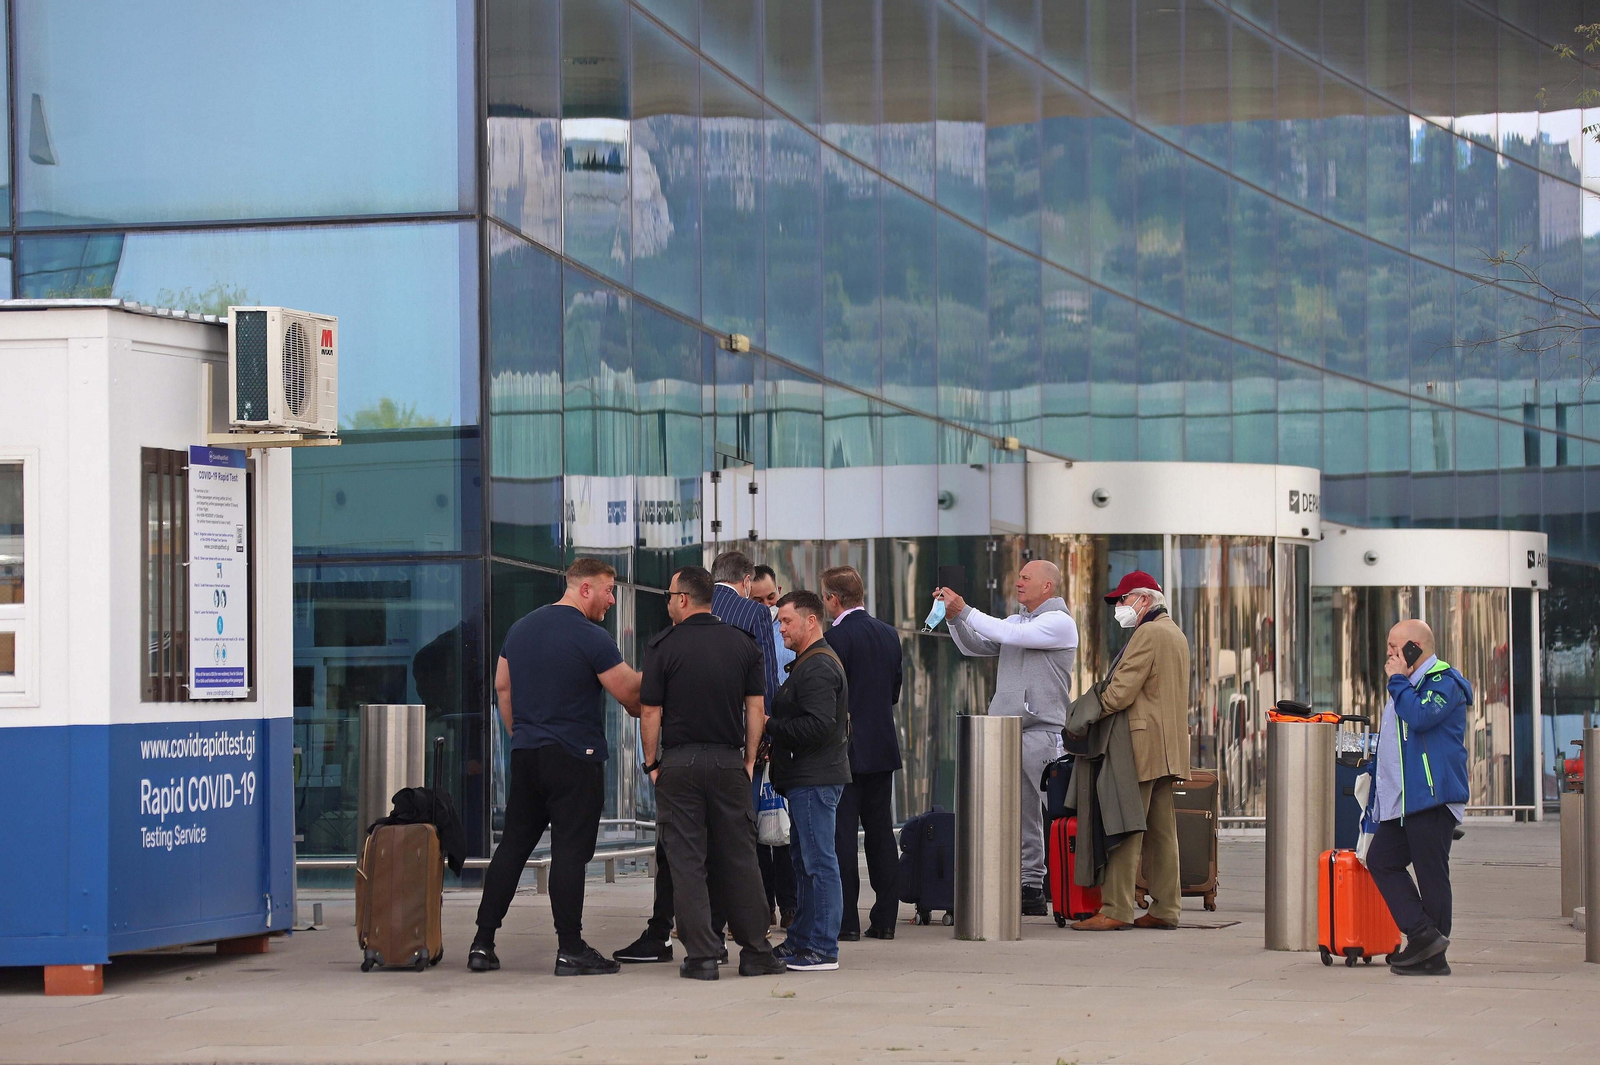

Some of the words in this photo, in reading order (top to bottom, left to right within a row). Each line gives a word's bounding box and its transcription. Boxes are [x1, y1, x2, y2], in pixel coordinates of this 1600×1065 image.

[198, 470, 217, 480] COVID-19
[218, 472, 229, 483] Rapid
[230, 473, 239, 482] Test
[1303, 493, 1320, 513] DEPA
[140, 730, 255, 762] www.covidrapidtest.gi
[140, 777, 183, 822] Rapid
[188, 771, 255, 812] COVID-19
[140, 826, 173, 852] Testing
[174, 823, 207, 846] Service
